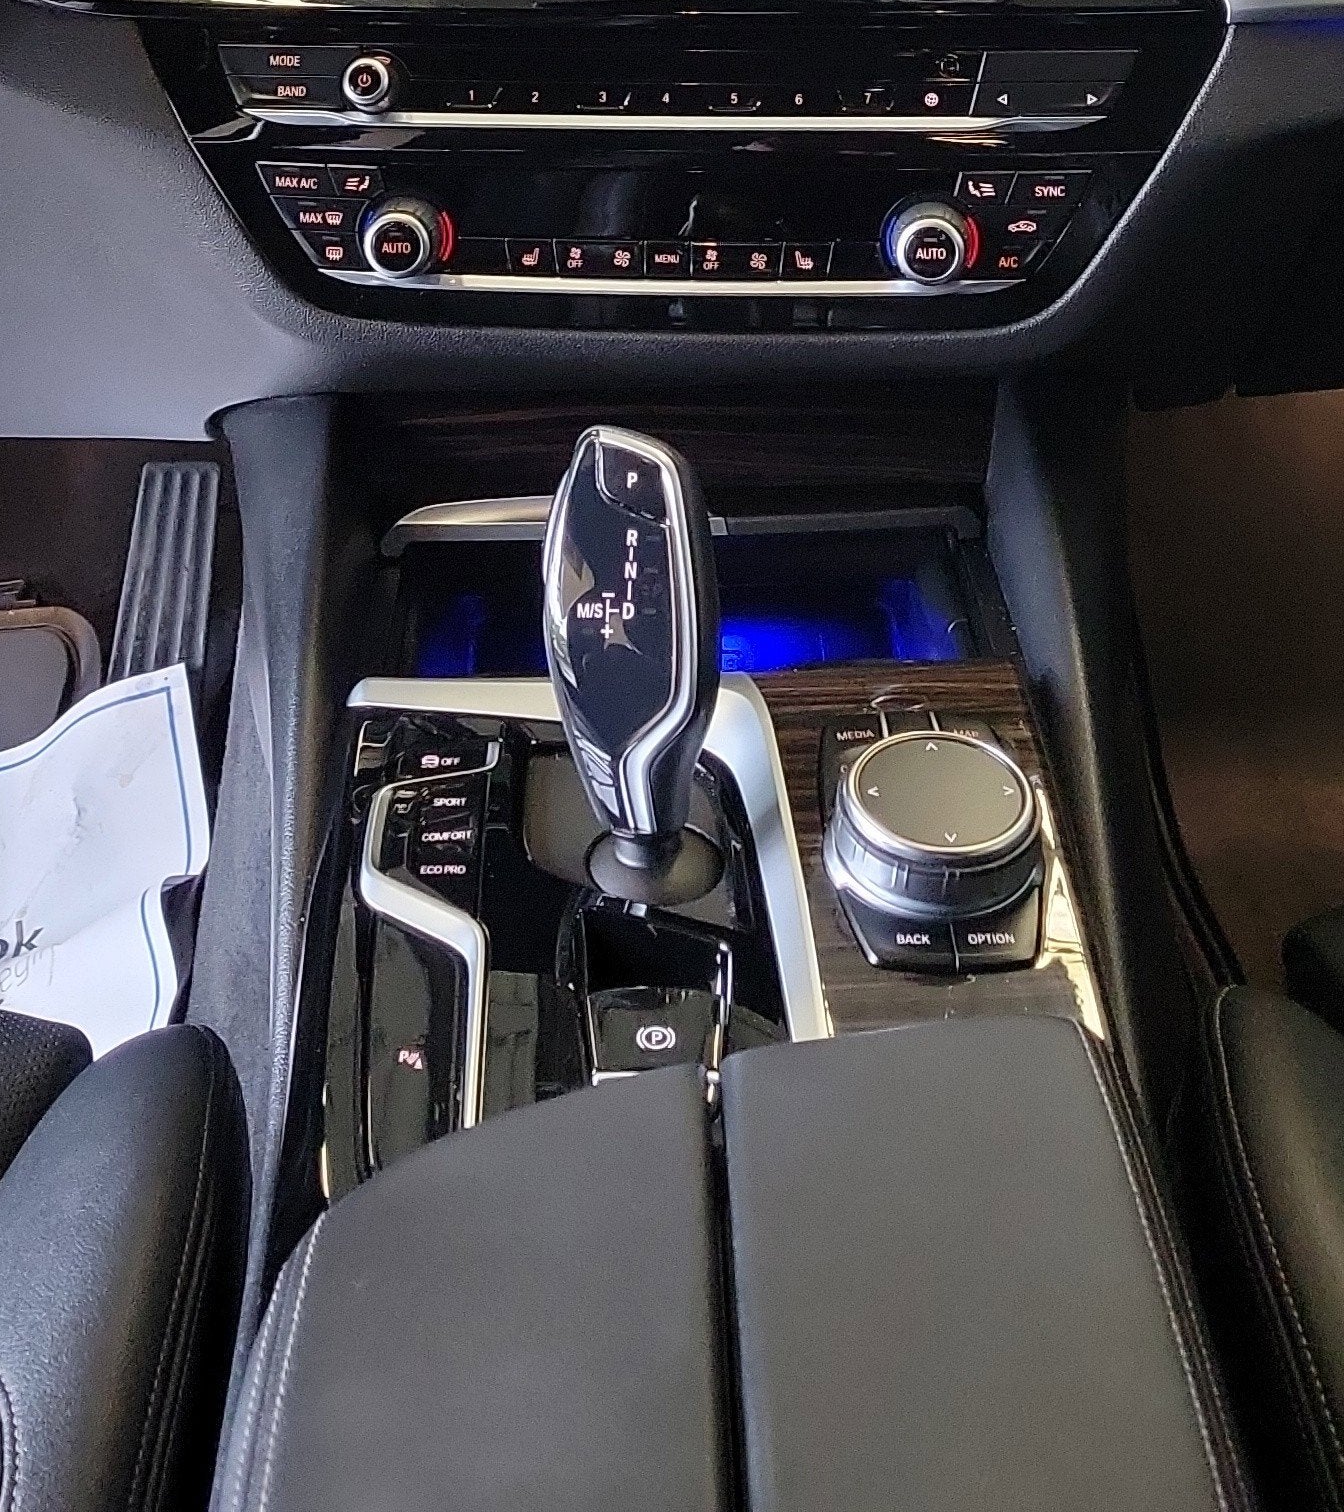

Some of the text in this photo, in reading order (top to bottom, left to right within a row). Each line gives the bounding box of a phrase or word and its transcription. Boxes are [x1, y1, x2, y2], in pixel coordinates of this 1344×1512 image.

[269, 54, 301, 67] MODE
[277, 85, 307, 97] BAND
[468, 89, 475, 101] 1
[531, 91, 539, 103] 2
[598, 91, 607, 103] 3
[661, 92, 670, 104] 4
[730, 92, 739, 104] 5
[794, 93, 804, 105] 6
[863, 92, 872, 105] 7
[275, 175, 318, 189] MAX A/C
[1034, 185, 1066, 197] SYNC
[299, 211, 324, 224] MAX
[381, 242, 412, 254] AUTO
[915, 247, 947, 260] AUTO
[567, 259, 584, 269] OFF
[654, 254, 680, 264] MENU
[998, 256, 1019, 268] A/C
[702, 261, 720, 271] OFF
[626, 471, 639, 489] P
[625, 529, 639, 547] R
[623, 561, 638, 579] N
[576, 602, 604, 619] M/S
[621, 602, 635, 620] D
[836, 728, 875, 742] MEDIA
[440, 756, 461, 766] OFF
[433, 796, 467, 807] SPORT
[421, 829, 474, 842] COMFORT
[419, 865, 467, 875] ECO PRO
[895, 932, 932, 945] BACK
[967, 932, 1016, 946] OPTION
